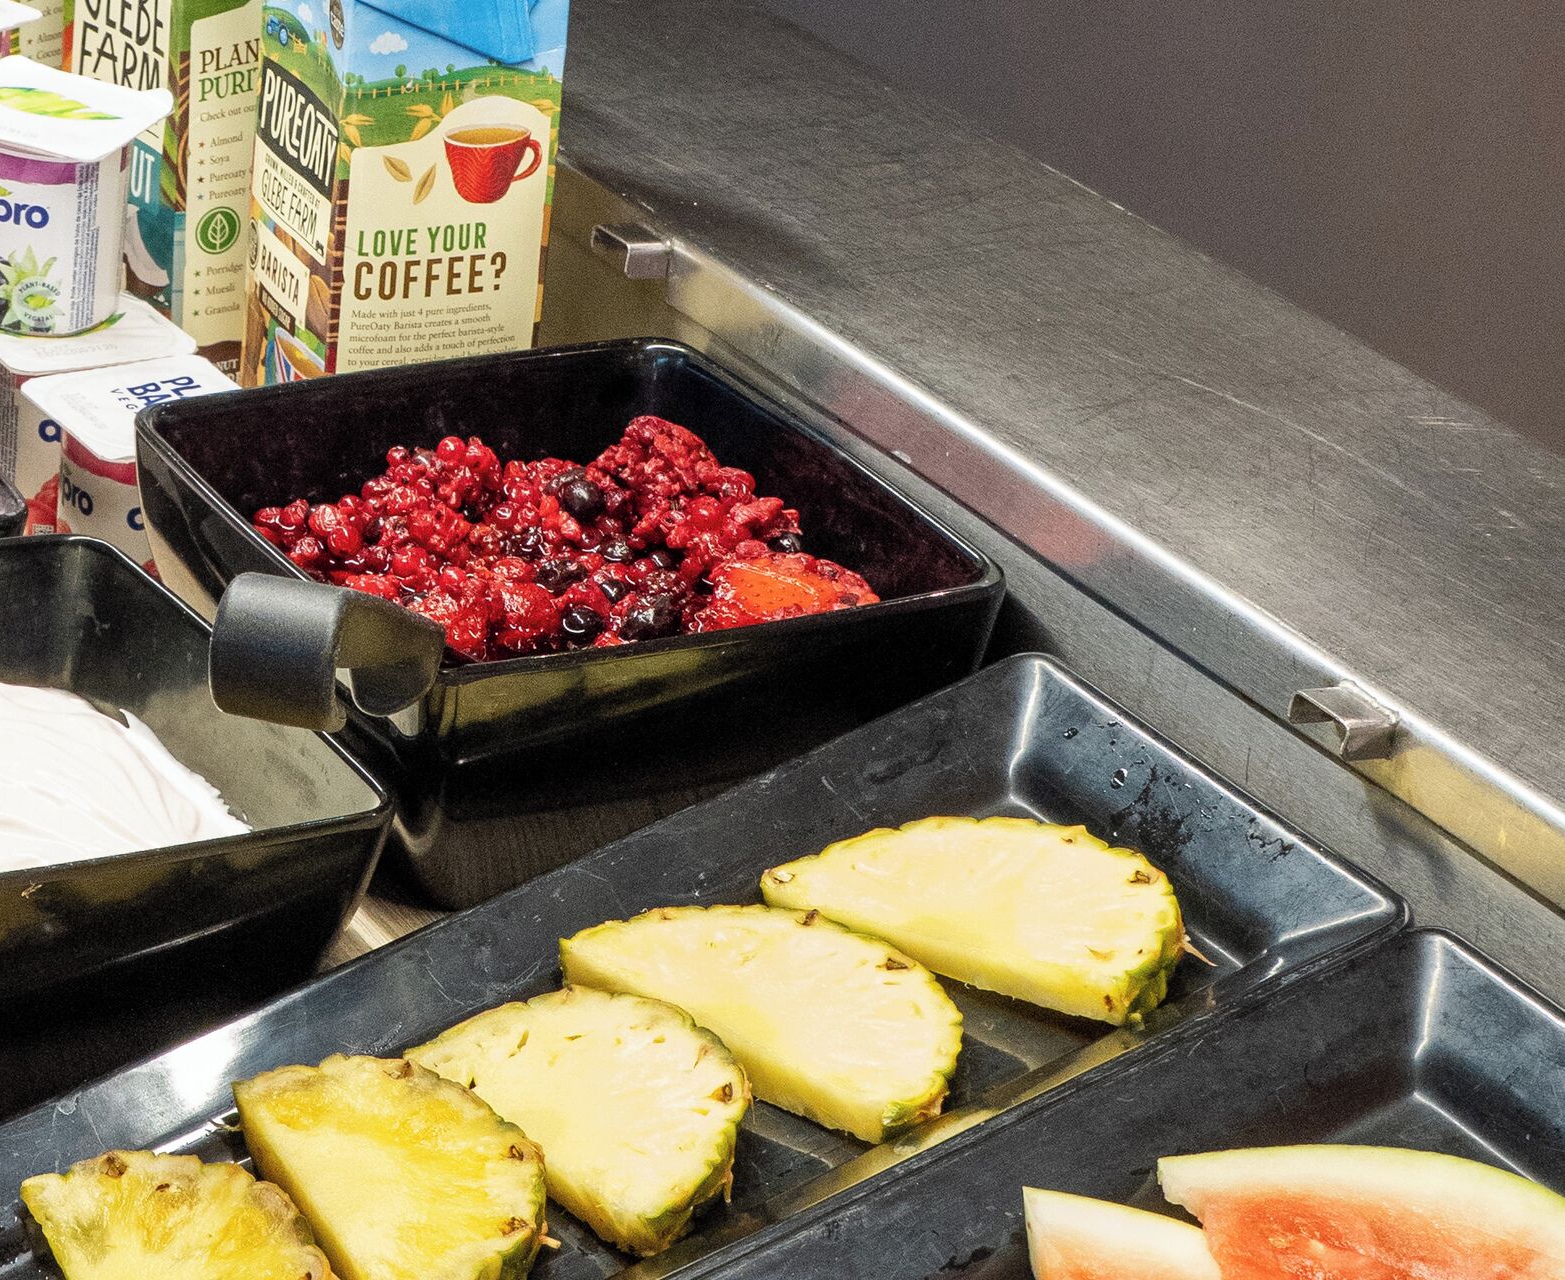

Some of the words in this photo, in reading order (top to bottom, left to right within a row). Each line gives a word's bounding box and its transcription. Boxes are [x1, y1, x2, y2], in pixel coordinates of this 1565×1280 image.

[79, 20, 161, 92] FARM
[198, 66, 259, 103] PURI
[200, 108, 225, 123] Check
[228, 105, 241, 117] out
[260, 68, 339, 188] PUREOATY
[209, 131, 243, 148] Almond
[209, 154, 230, 166] Soya
[209, 169, 247, 183] Pureoaty
[209, 186, 247, 201] Pureoaty
[262, 169, 288, 216] GLEBE
[287, 192, 318, 245] FARM
[357, 228, 419, 258] LOVE
[426, 221, 487, 253] YOUR
[206, 262, 244, 276] Porridge
[261, 243, 300, 307] BARISTA
[352, 251, 508, 301] COFFEE?
[205, 283, 236, 297] Muesli
[204, 302, 241, 316] Granola
[350, 309, 377, 319] Made
[378, 307, 398, 318] with
[399, 307, 416, 320] just
[417, 308, 423, 317] 4
[425, 308, 445, 321] pure
[446, 303, 492, 317] ingredients,
[350, 320, 392, 333] PureOaty
[393, 320, 423, 330] Barista
[424, 318, 453, 328] creates
[461, 314, 491, 324] smooth
[349, 332, 397, 343] microfoam
[398, 331, 411, 342] for
[412, 331, 427, 341] the
[428, 328, 457, 341] perfect
[458, 323, 505, 338] barista-style
[348, 344, 376, 355] coffee
[376, 343, 393, 354] and
[395, 342, 413, 353] also
[414, 340, 434, 352] adds
[442, 338, 465, 349] touch
[467, 337, 477, 348] of
[477, 334, 516, 349] perfection
[347, 357, 357, 367] to
[359, 358, 380, 369] your
